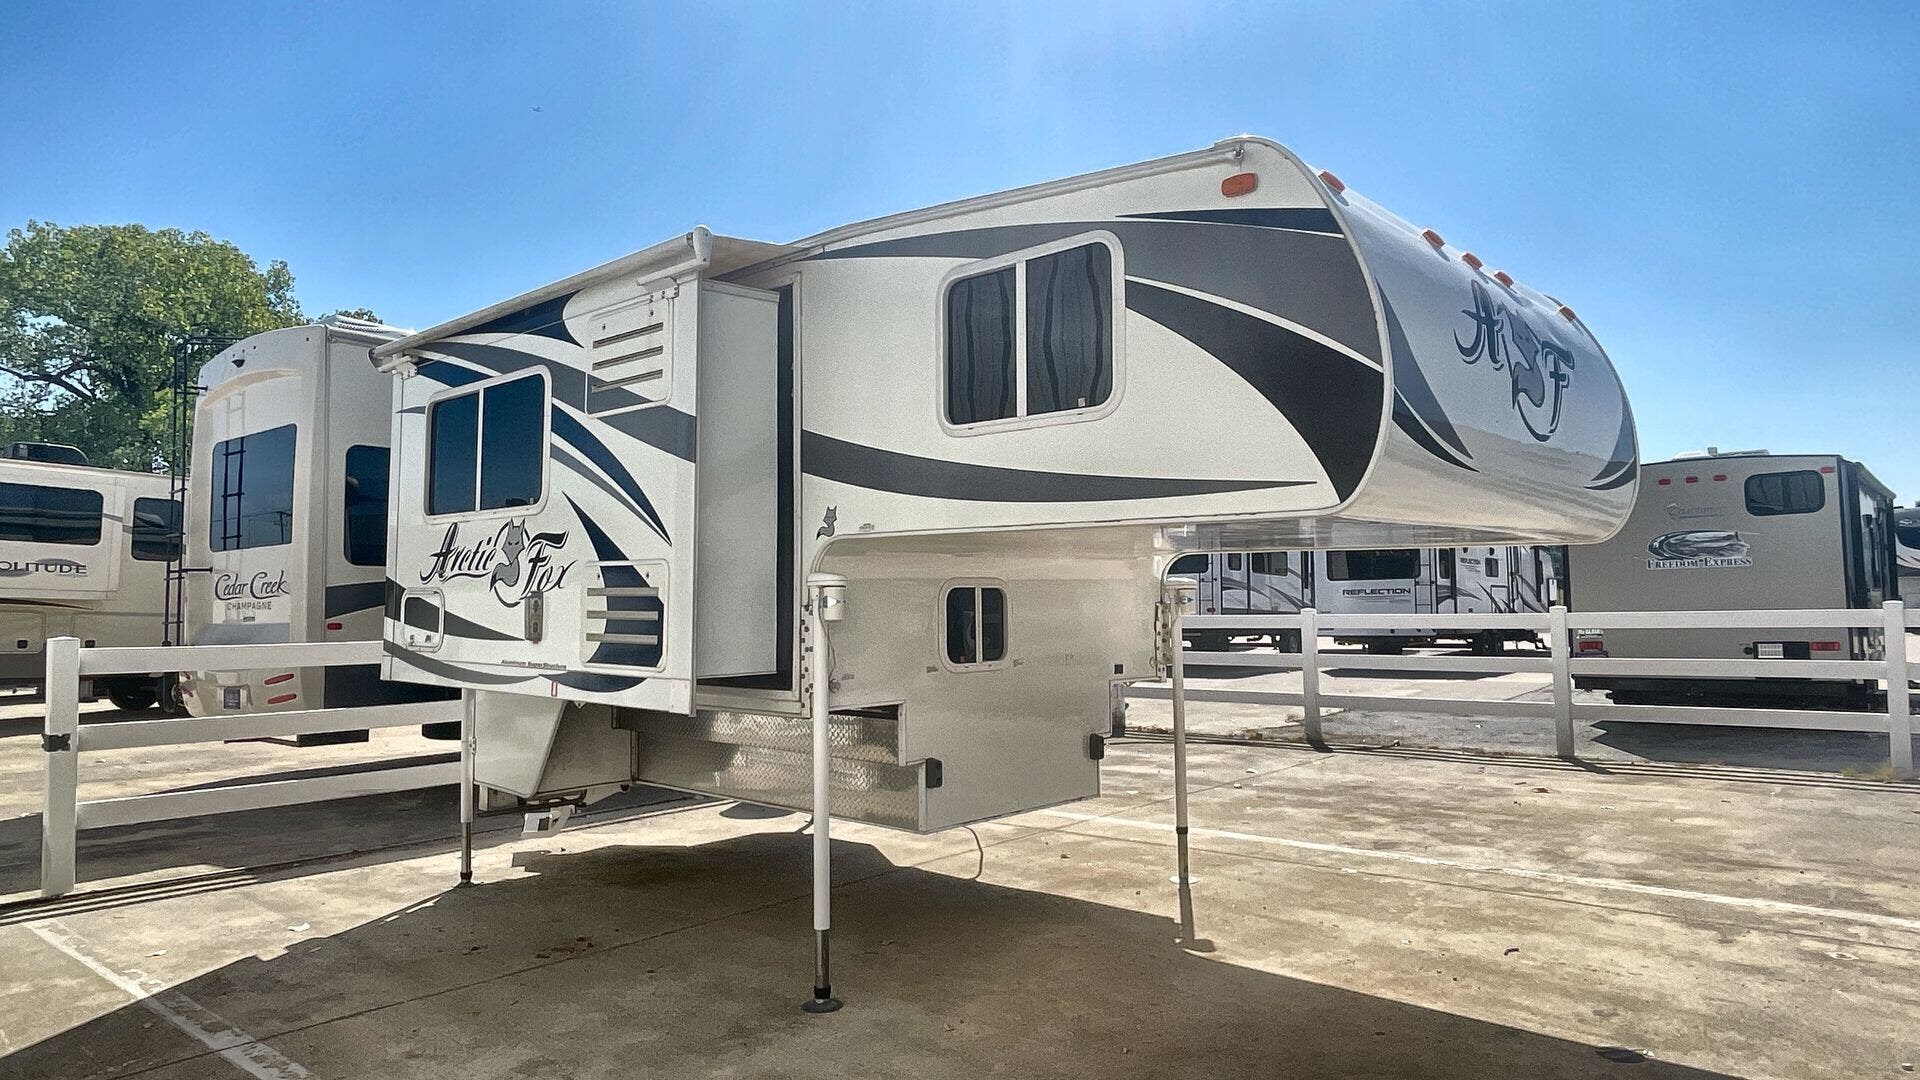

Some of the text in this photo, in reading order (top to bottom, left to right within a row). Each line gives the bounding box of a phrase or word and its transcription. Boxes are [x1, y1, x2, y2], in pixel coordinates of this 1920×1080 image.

[420, 522, 578, 600] Arctic Fox
[1647, 557, 1752, 569] FREEDOM EXPRESS
[215, 569, 290, 601] Cedar Creek
[1342, 588, 1412, 596] REFLECTION
[226, 601, 272, 611] CHAMPAGNE
